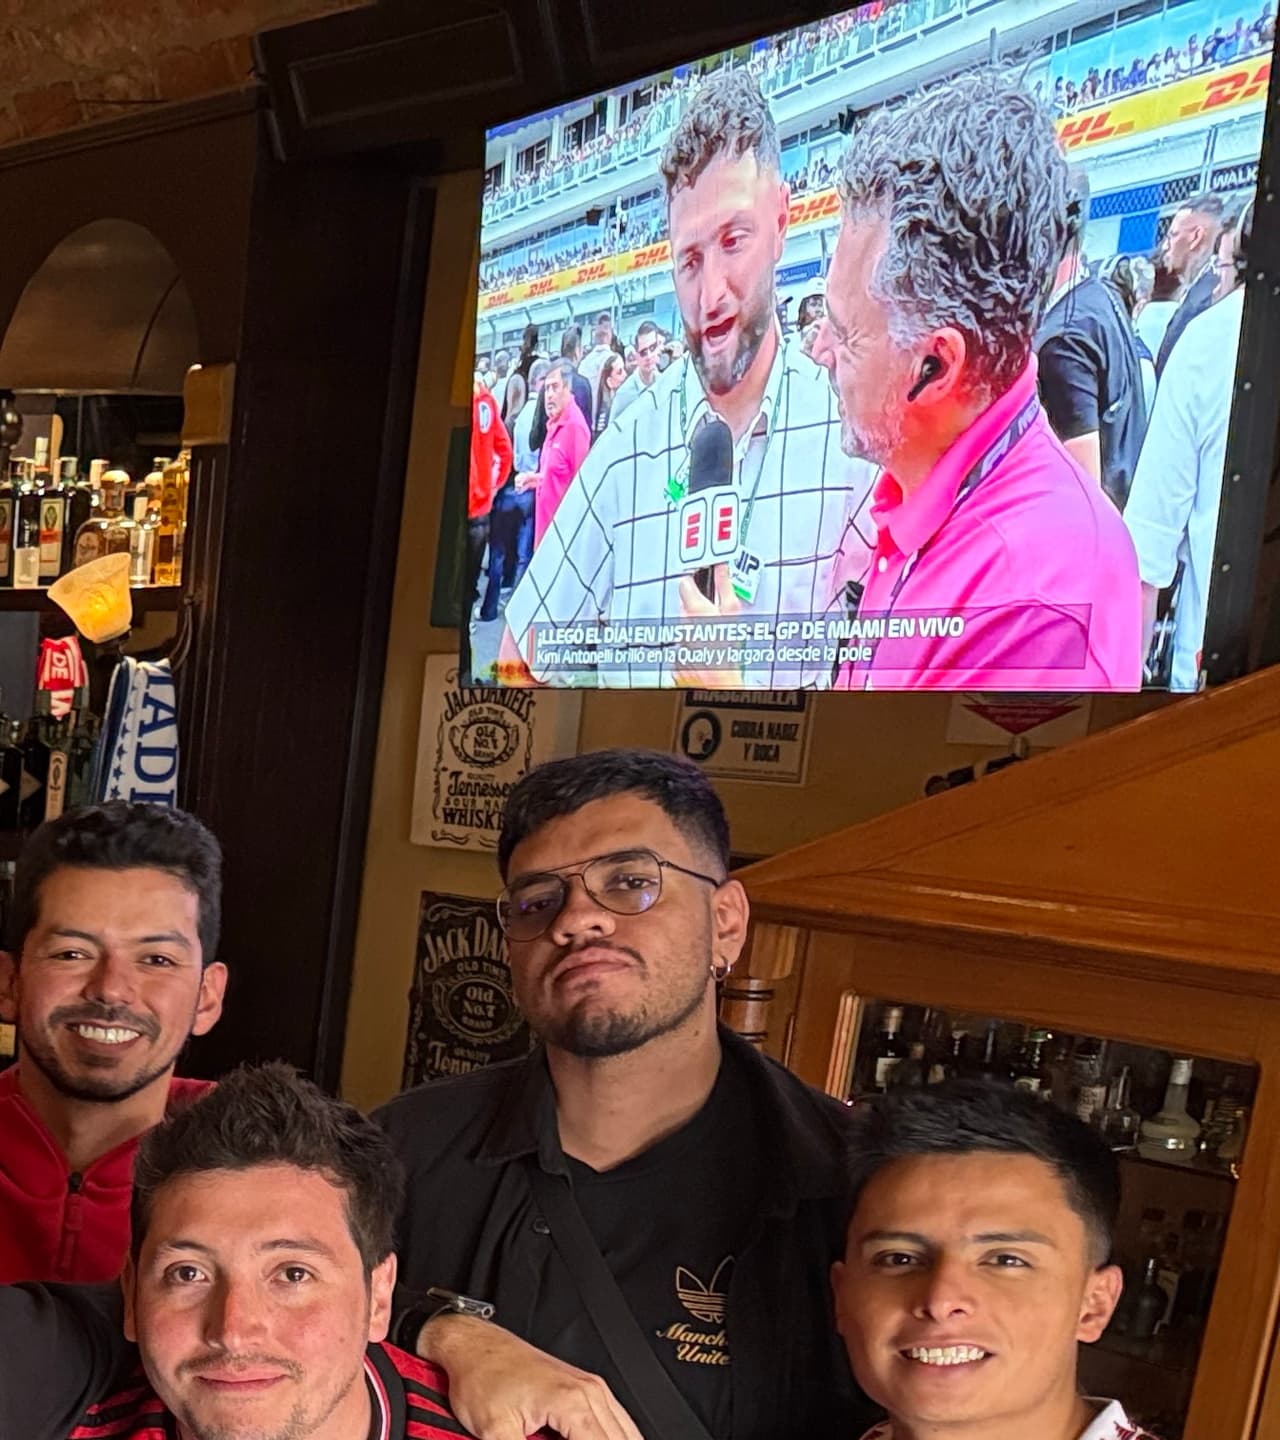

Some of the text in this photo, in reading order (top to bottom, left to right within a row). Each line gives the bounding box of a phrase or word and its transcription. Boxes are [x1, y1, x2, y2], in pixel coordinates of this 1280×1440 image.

[1060, 111, 1114, 147] HL
[790, 195, 840, 224] DHL
[634, 246, 669, 269] DHL
[576, 264, 606, 283] DHL
[528, 279, 559, 296] DHL
[538, 616, 964, 647] ¡LLEGÓ EL DÍA! EN INSTANTES: EL GP DE MIAMI EN VIVO
[536, 648, 561, 664] Kimi
[562, 648, 613, 664] Antonelli
[614, 646, 645, 664] brilló
[647, 651, 663, 663] en
[664, 648, 676, 663] la
[678, 647, 714, 666] Qualy
[716, 651, 726, 666] y
[777, 646, 820, 662] desde
[823, 646, 836, 661] la
[839, 646, 871, 664] pole
[744, 743, 752, 761] Y
[423, 927, 470, 973] JACK
[656, 1322, 728, 1346] Manch
[676, 1344, 731, 1365] Unite
